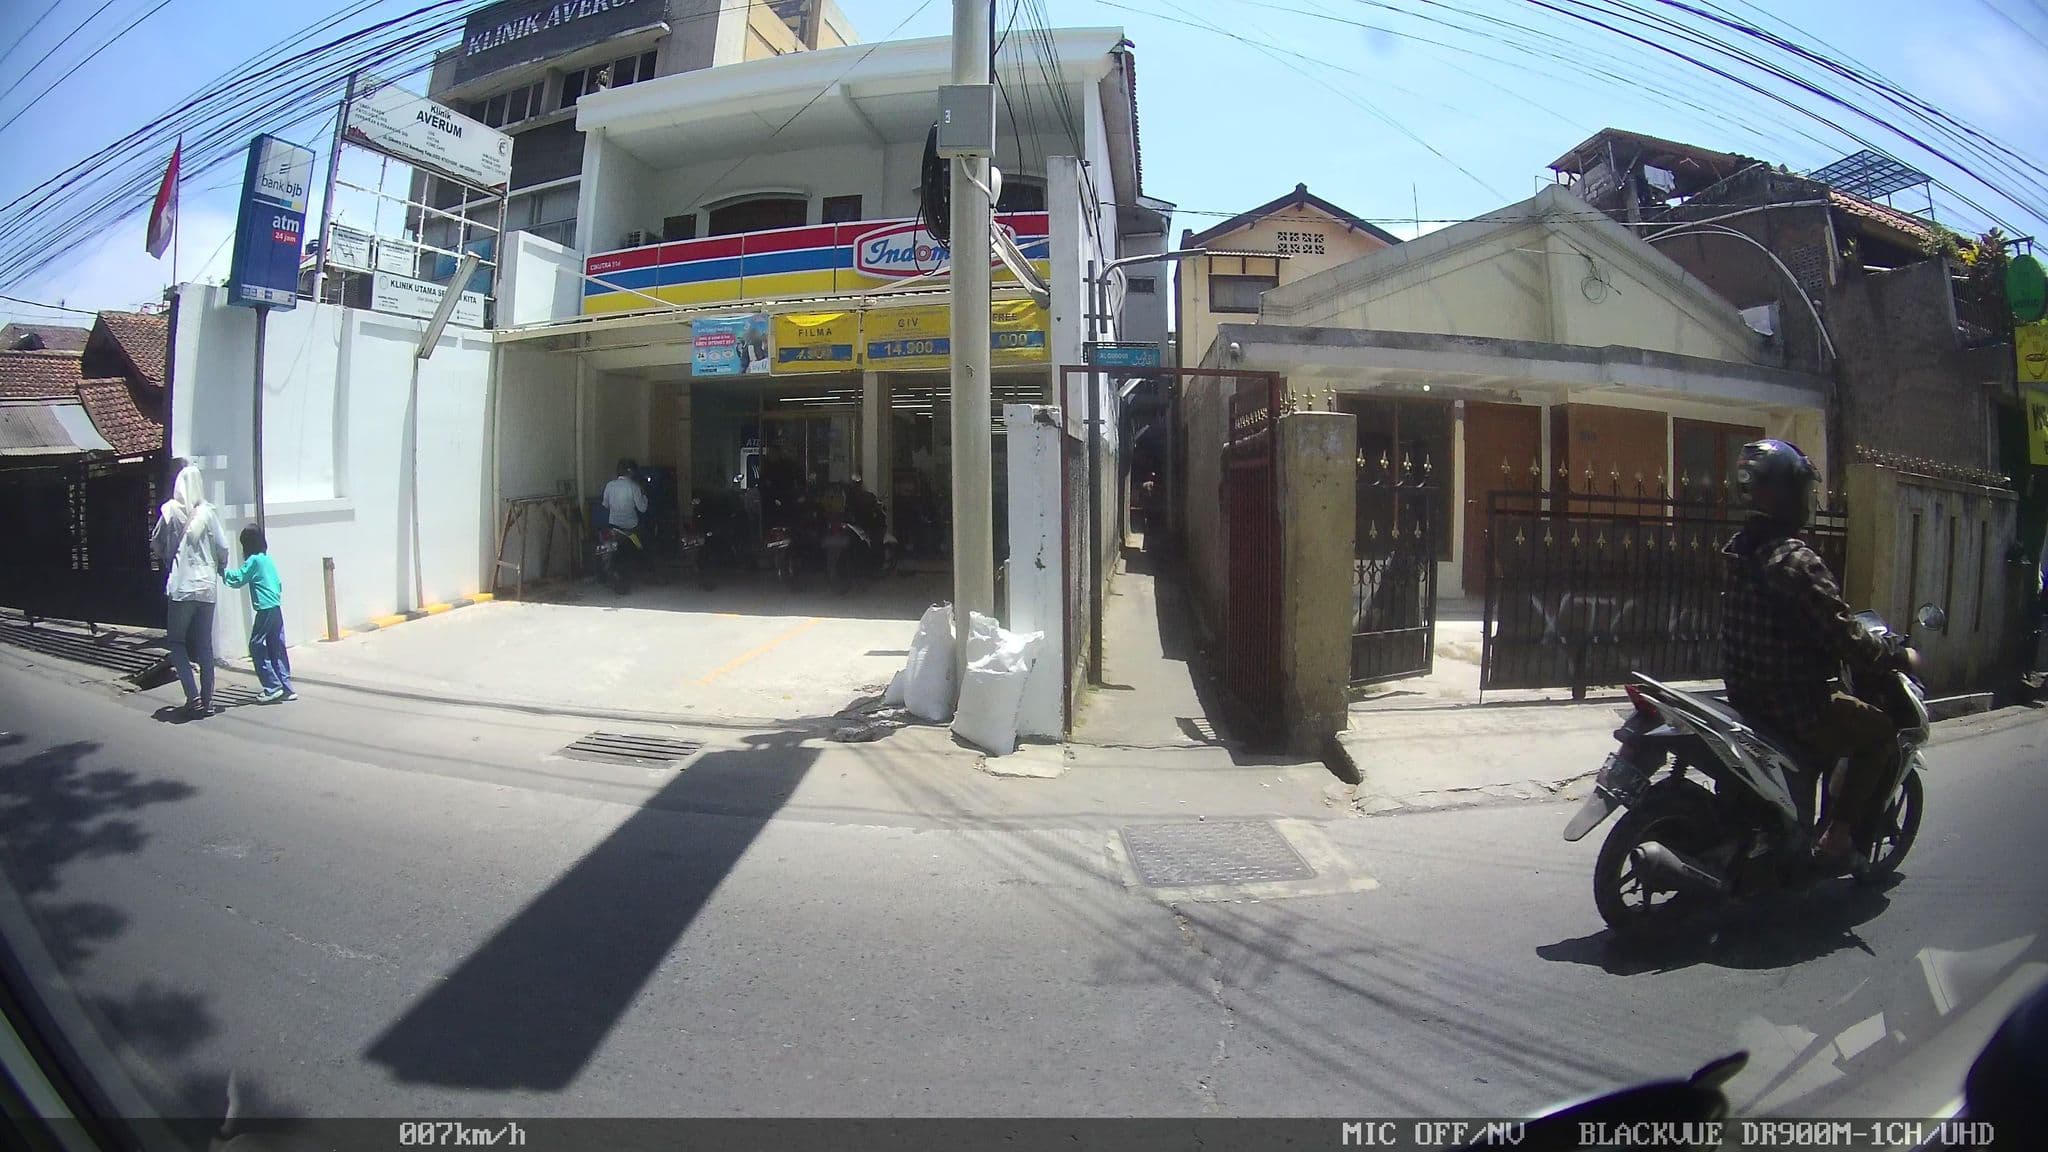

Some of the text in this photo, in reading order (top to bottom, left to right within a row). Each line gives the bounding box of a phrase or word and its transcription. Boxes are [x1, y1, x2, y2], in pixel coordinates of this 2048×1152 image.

[466, 0, 635, 57] KLINIK AVER
[430, 104, 451, 121] Klinik
[416, 110, 462, 138] AVERUM
[261, 174, 303, 197] bank bjb
[272, 214, 300, 233] atm
[274, 231, 296, 243] 24 jam
[864, 238, 950, 264] Indom
[390, 279, 413, 292] KLINIK
[414, 284, 437, 297] UTAMA
[463, 294, 477, 305] KITA
[798, 327, 832, 337] FILMA
[897, 317, 919, 328] GIV
